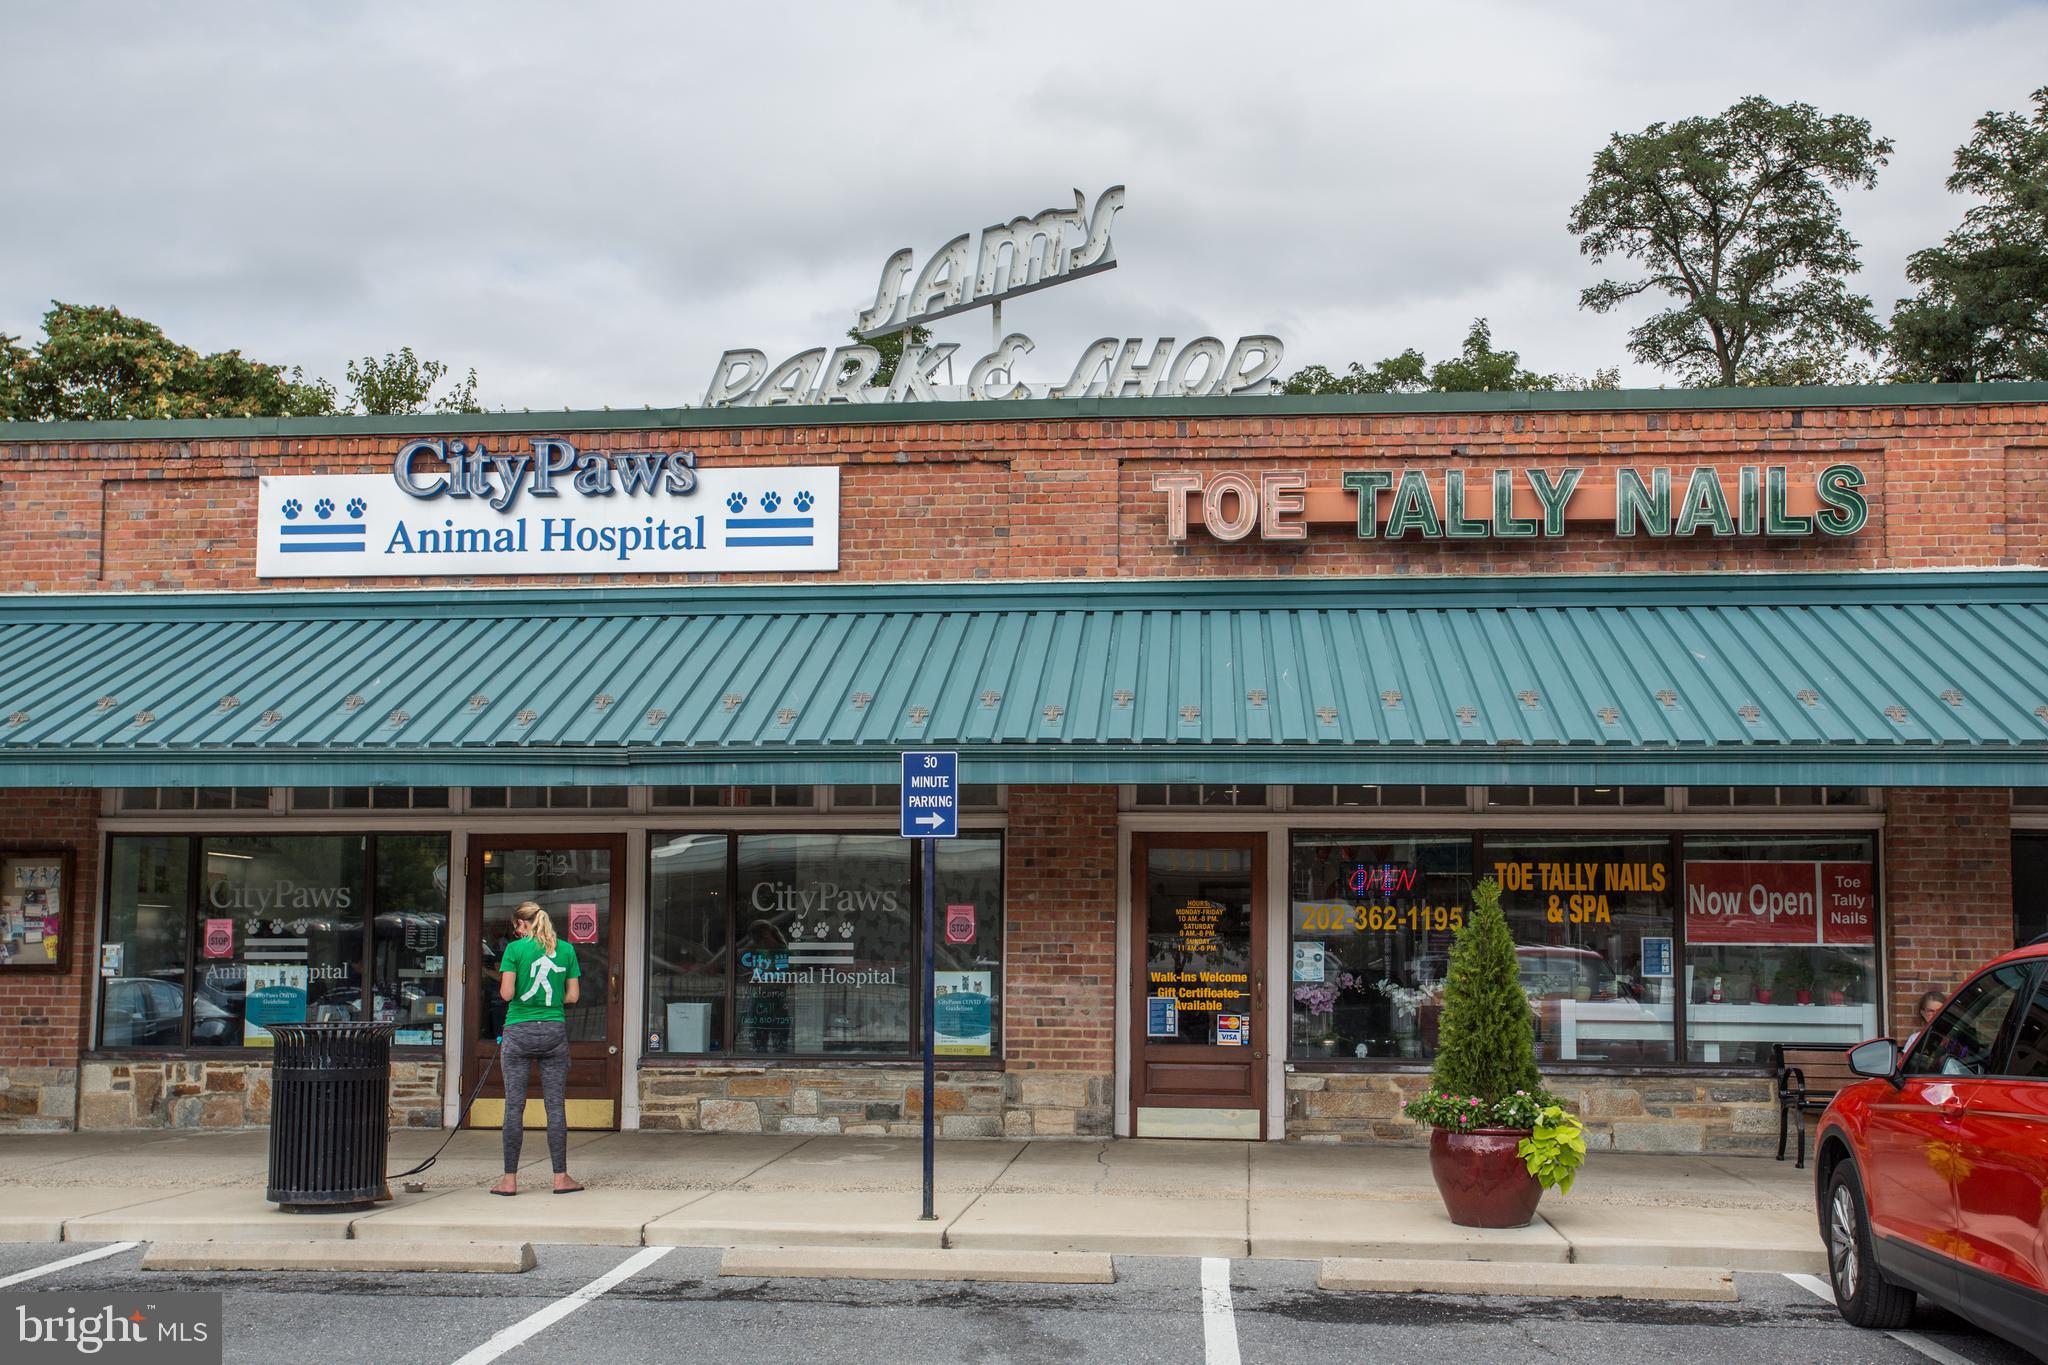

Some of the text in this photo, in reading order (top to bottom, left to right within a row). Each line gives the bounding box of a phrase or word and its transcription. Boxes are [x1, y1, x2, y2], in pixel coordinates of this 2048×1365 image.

[700, 333, 1284, 408] PARK & SHOP
[393, 438, 698, 512] CityPaws
[1152, 464, 1869, 540] TOE TALLY NAILS
[384, 515, 706, 561] Animal Hospital
[923, 756, 938, 769] 30
[911, 775, 950, 788] MINUTE
[908, 795, 953, 808] PARKING
[1349, 868, 1418, 891] OPEN
[1494, 862, 1666, 892] TOE TALLY NAILS
[1834, 875, 1862, 888] Toe
[209, 879, 351, 916] CityPaws
[751, 881, 898, 919] CityPaws
[1689, 883, 1813, 923] Now Open
[1831, 893, 1866, 909] Tally
[1547, 894, 1612, 923] & SPA
[574, 922, 593, 931] STOP
[1301, 905, 1464, 932] 202-362-1195
[1830, 912, 1868, 924] Nails
[951, 923, 970, 933] STOP
[210, 937, 229, 946] STOP
[741, 952, 772, 969] City
[749, 967, 897, 989] Animal Hospital
[1151, 972, 1248, 983] Walk-Ins Welcome
[1157, 987, 1240, 998] Gift Certificates
[1175, 1000, 1223, 1011] Available
